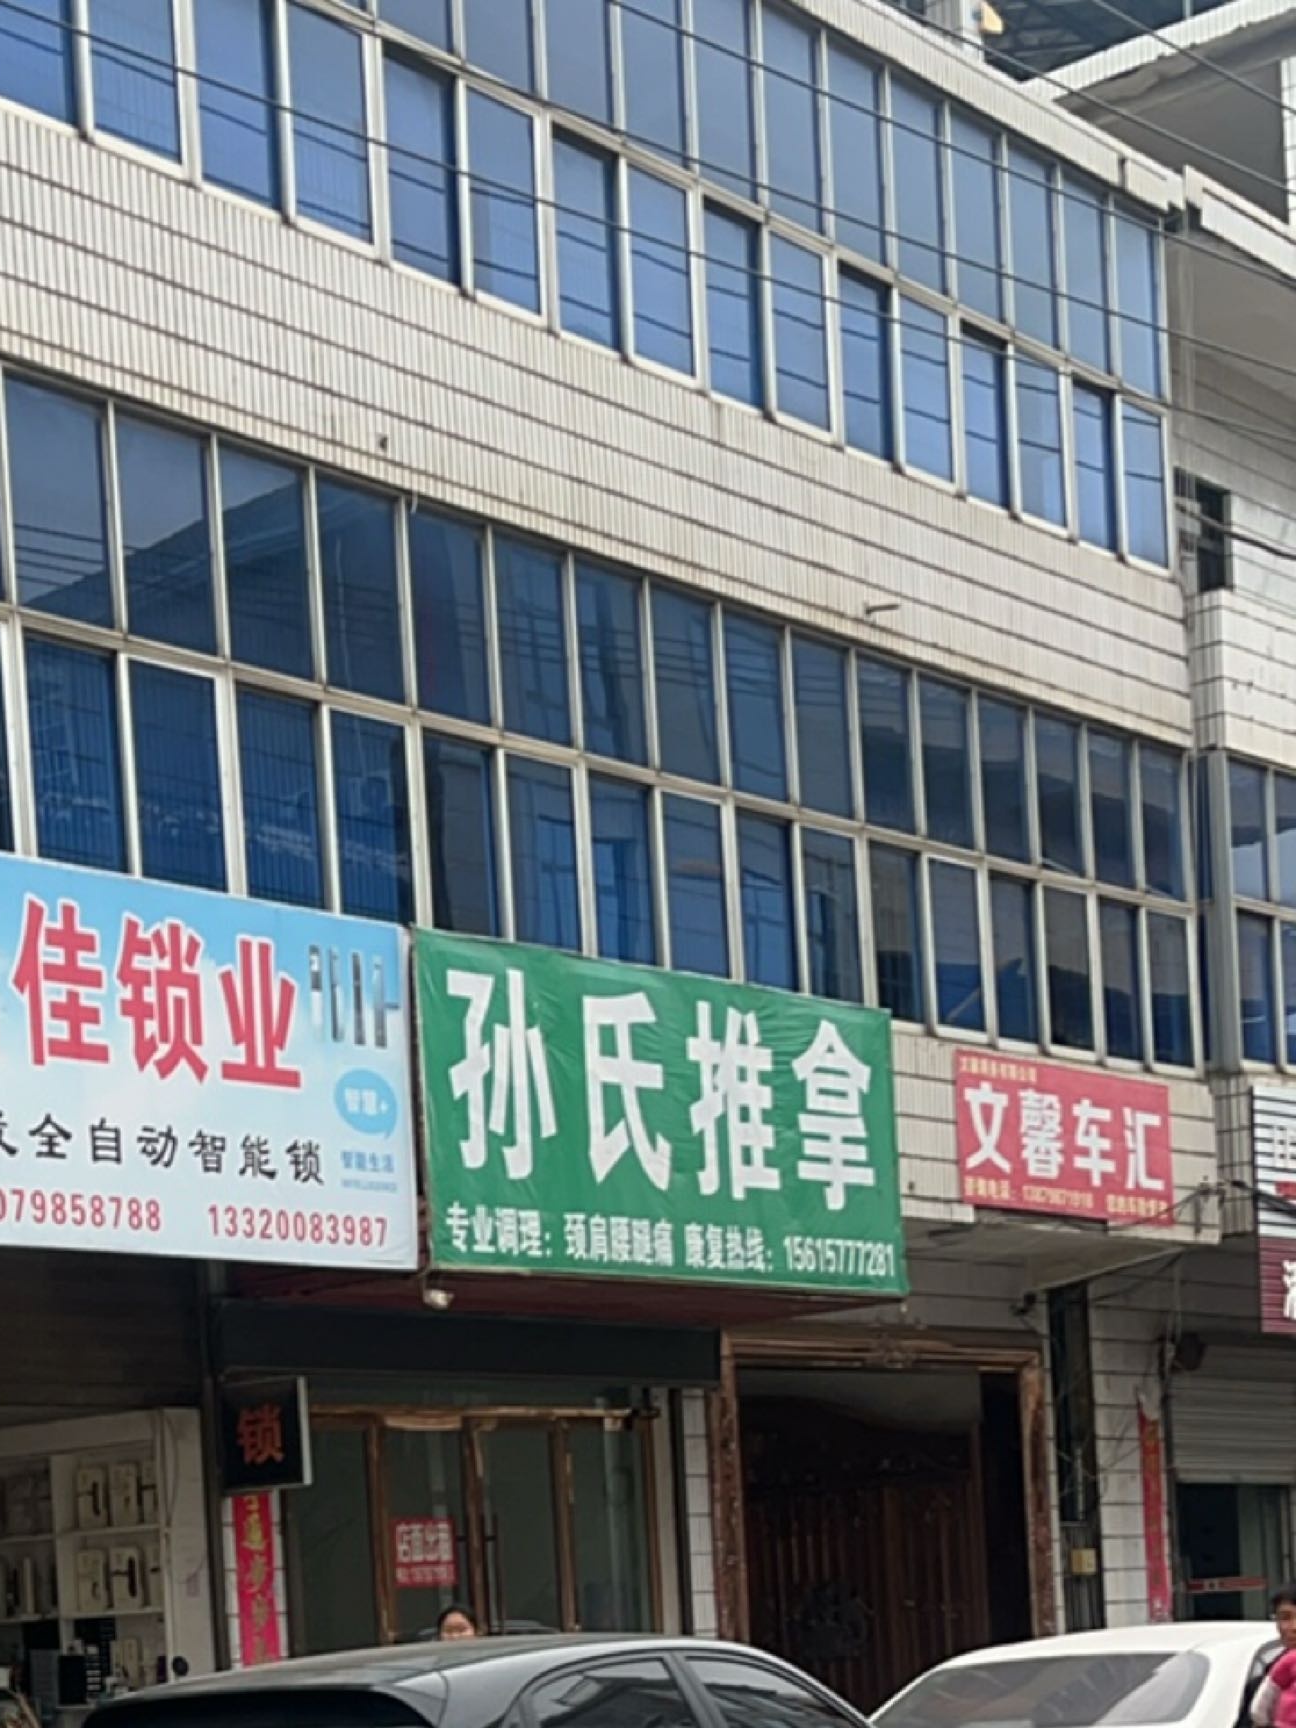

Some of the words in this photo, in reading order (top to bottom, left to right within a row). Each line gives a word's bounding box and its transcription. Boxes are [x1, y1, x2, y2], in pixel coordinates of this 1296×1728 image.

[445, 968, 876, 1212] 孙氏推拿
[962, 1080, 1166, 1192] 文馨车汇
[207, 1204, 388, 1248] 13320083987
[236, 1402, 286, 1465] 锁
